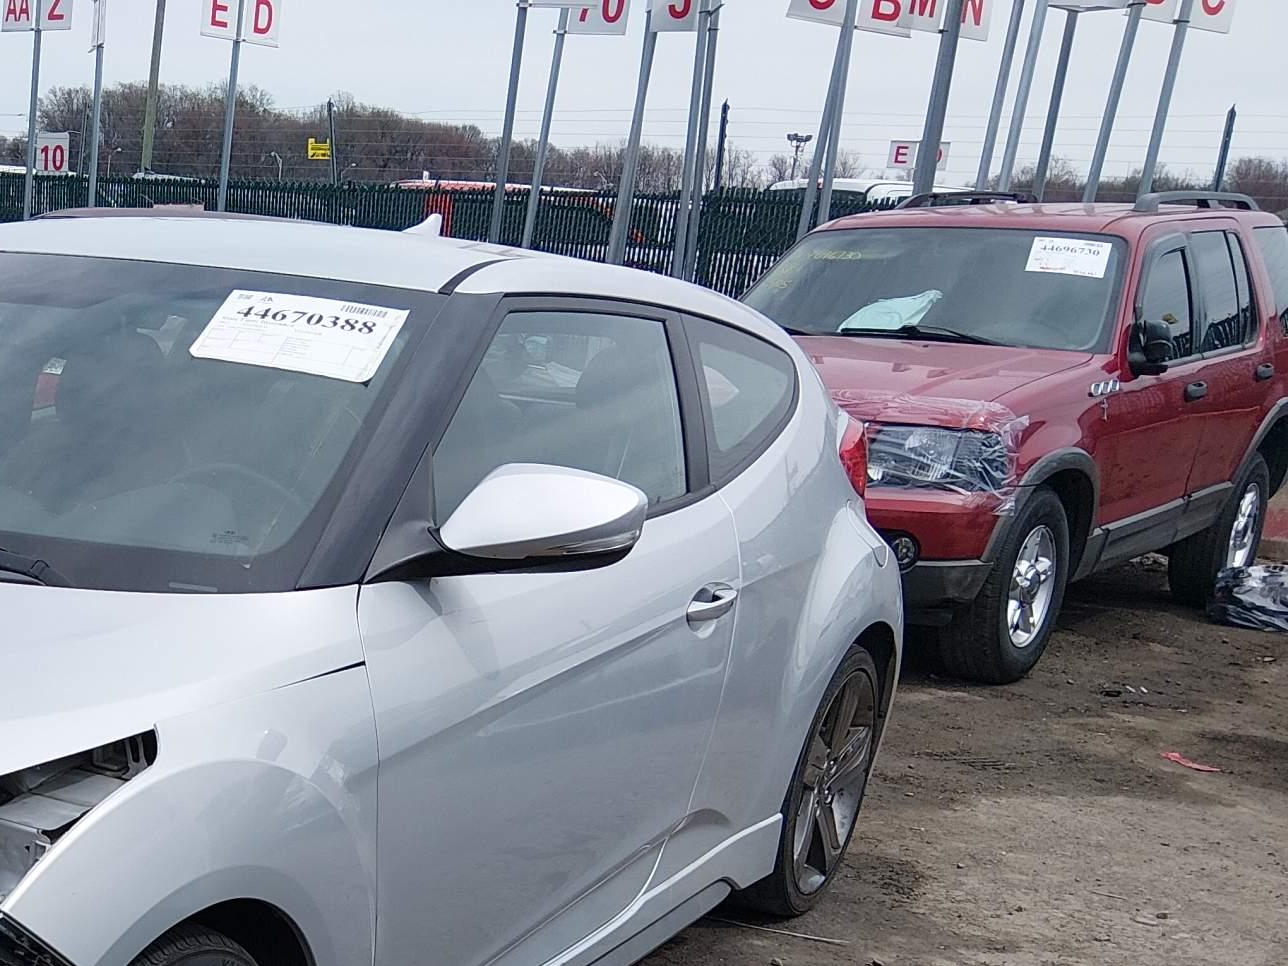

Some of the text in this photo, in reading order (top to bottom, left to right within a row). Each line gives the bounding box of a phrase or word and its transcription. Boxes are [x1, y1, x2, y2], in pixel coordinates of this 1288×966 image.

[5, 0, 30, 22] AA
[210, 0, 229, 28] E
[253, 0, 273, 34] D
[40, 144, 65, 171] 10
[893, 146, 910, 164] E
[236, 305, 378, 335] 44670388
